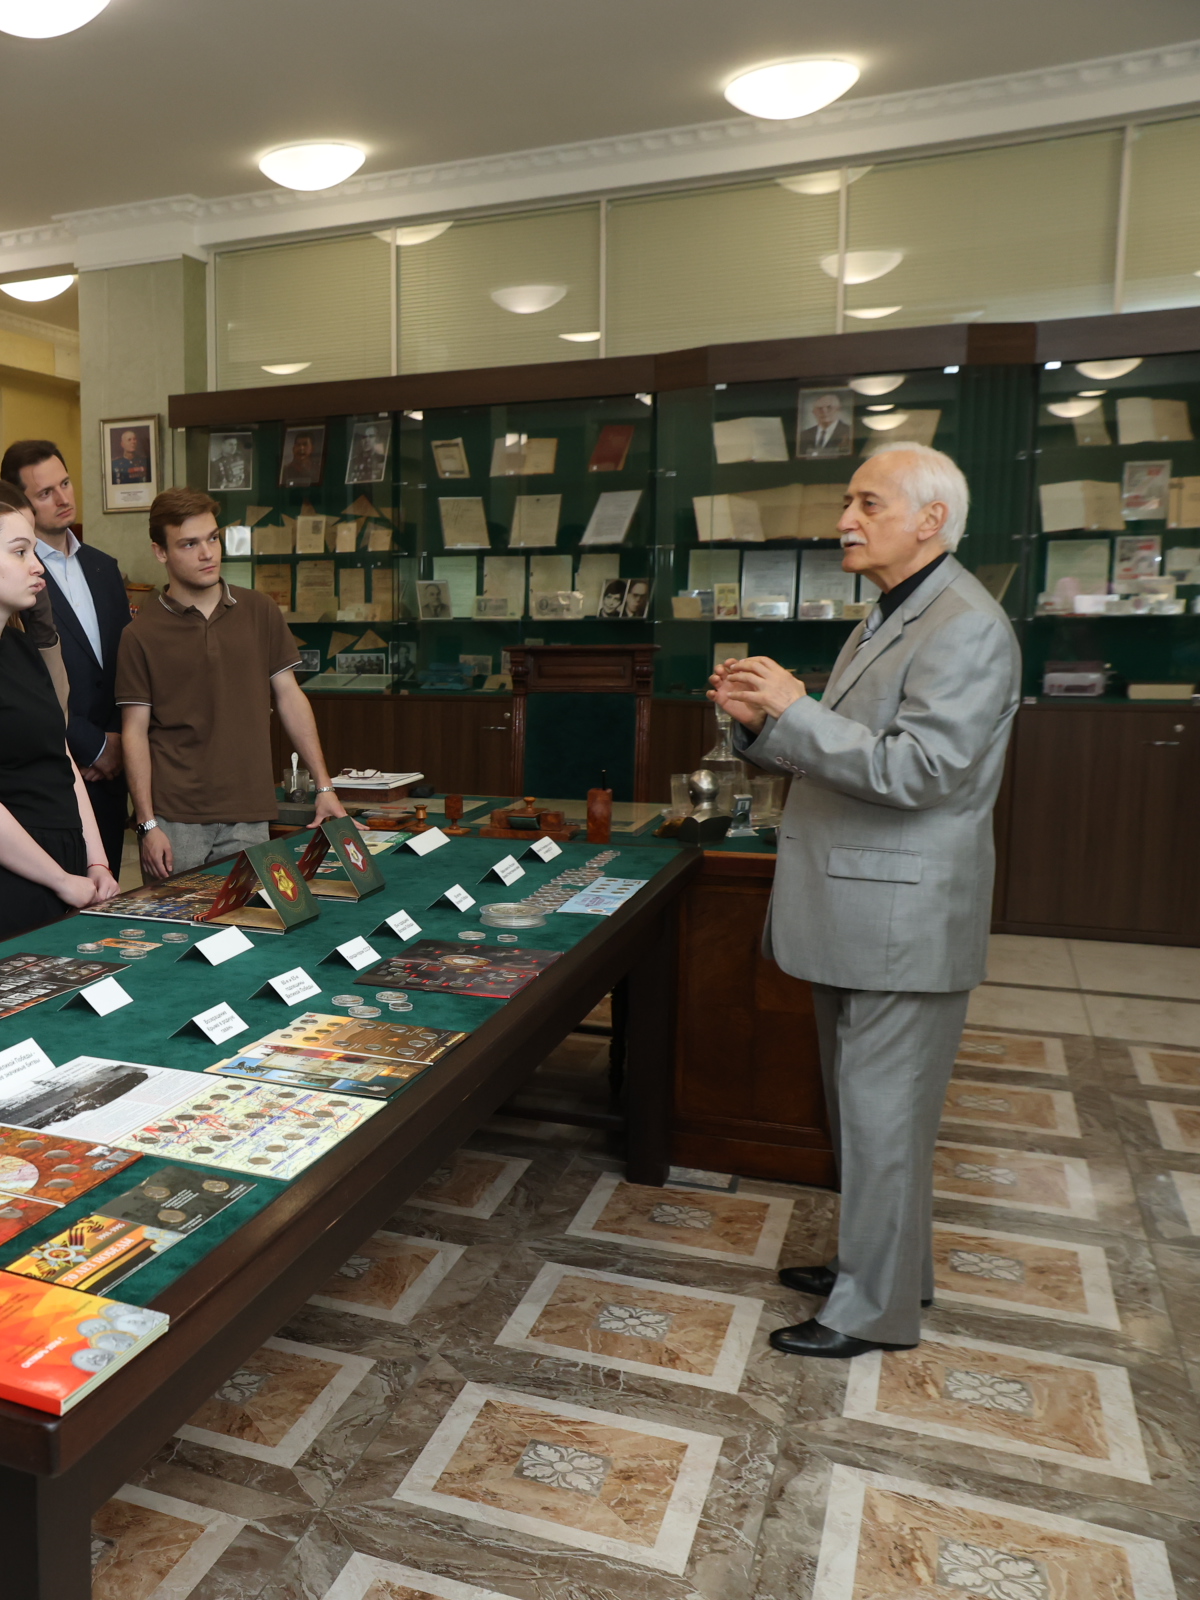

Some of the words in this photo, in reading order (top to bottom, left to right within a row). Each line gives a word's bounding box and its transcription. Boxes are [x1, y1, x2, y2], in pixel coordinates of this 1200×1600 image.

[62, 1273, 80, 1283] 70
[75, 1262, 97, 1276] ЛЕТ
[92, 1237, 135, 1264] ПОБЕДЫ
